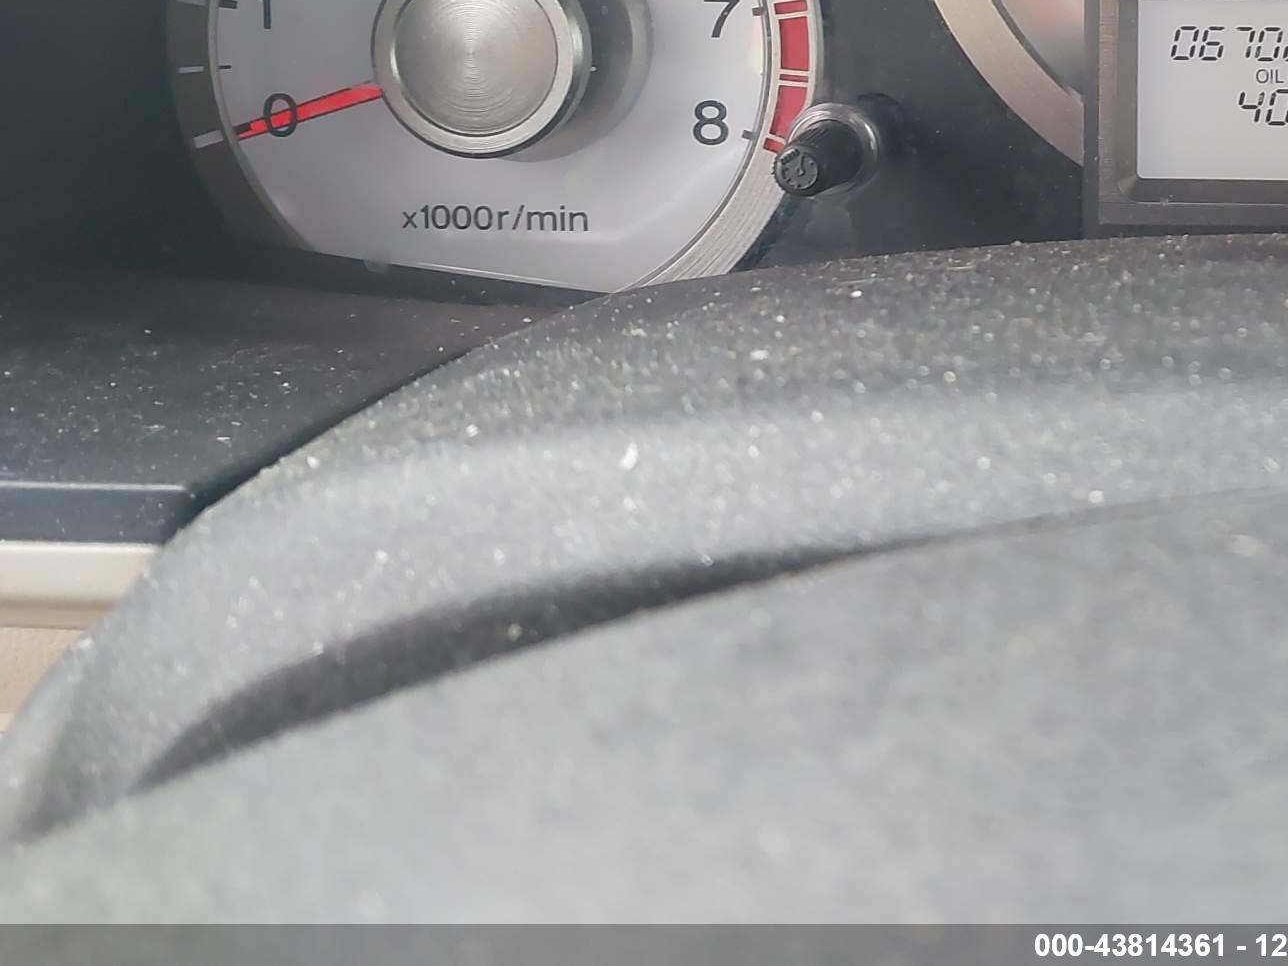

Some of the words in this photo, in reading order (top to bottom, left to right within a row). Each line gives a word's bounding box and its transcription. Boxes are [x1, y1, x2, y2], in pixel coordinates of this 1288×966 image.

[1256, 69, 1284, 83] OIL
[262, 93, 298, 138] 0
[693, 100, 728, 145] 8
